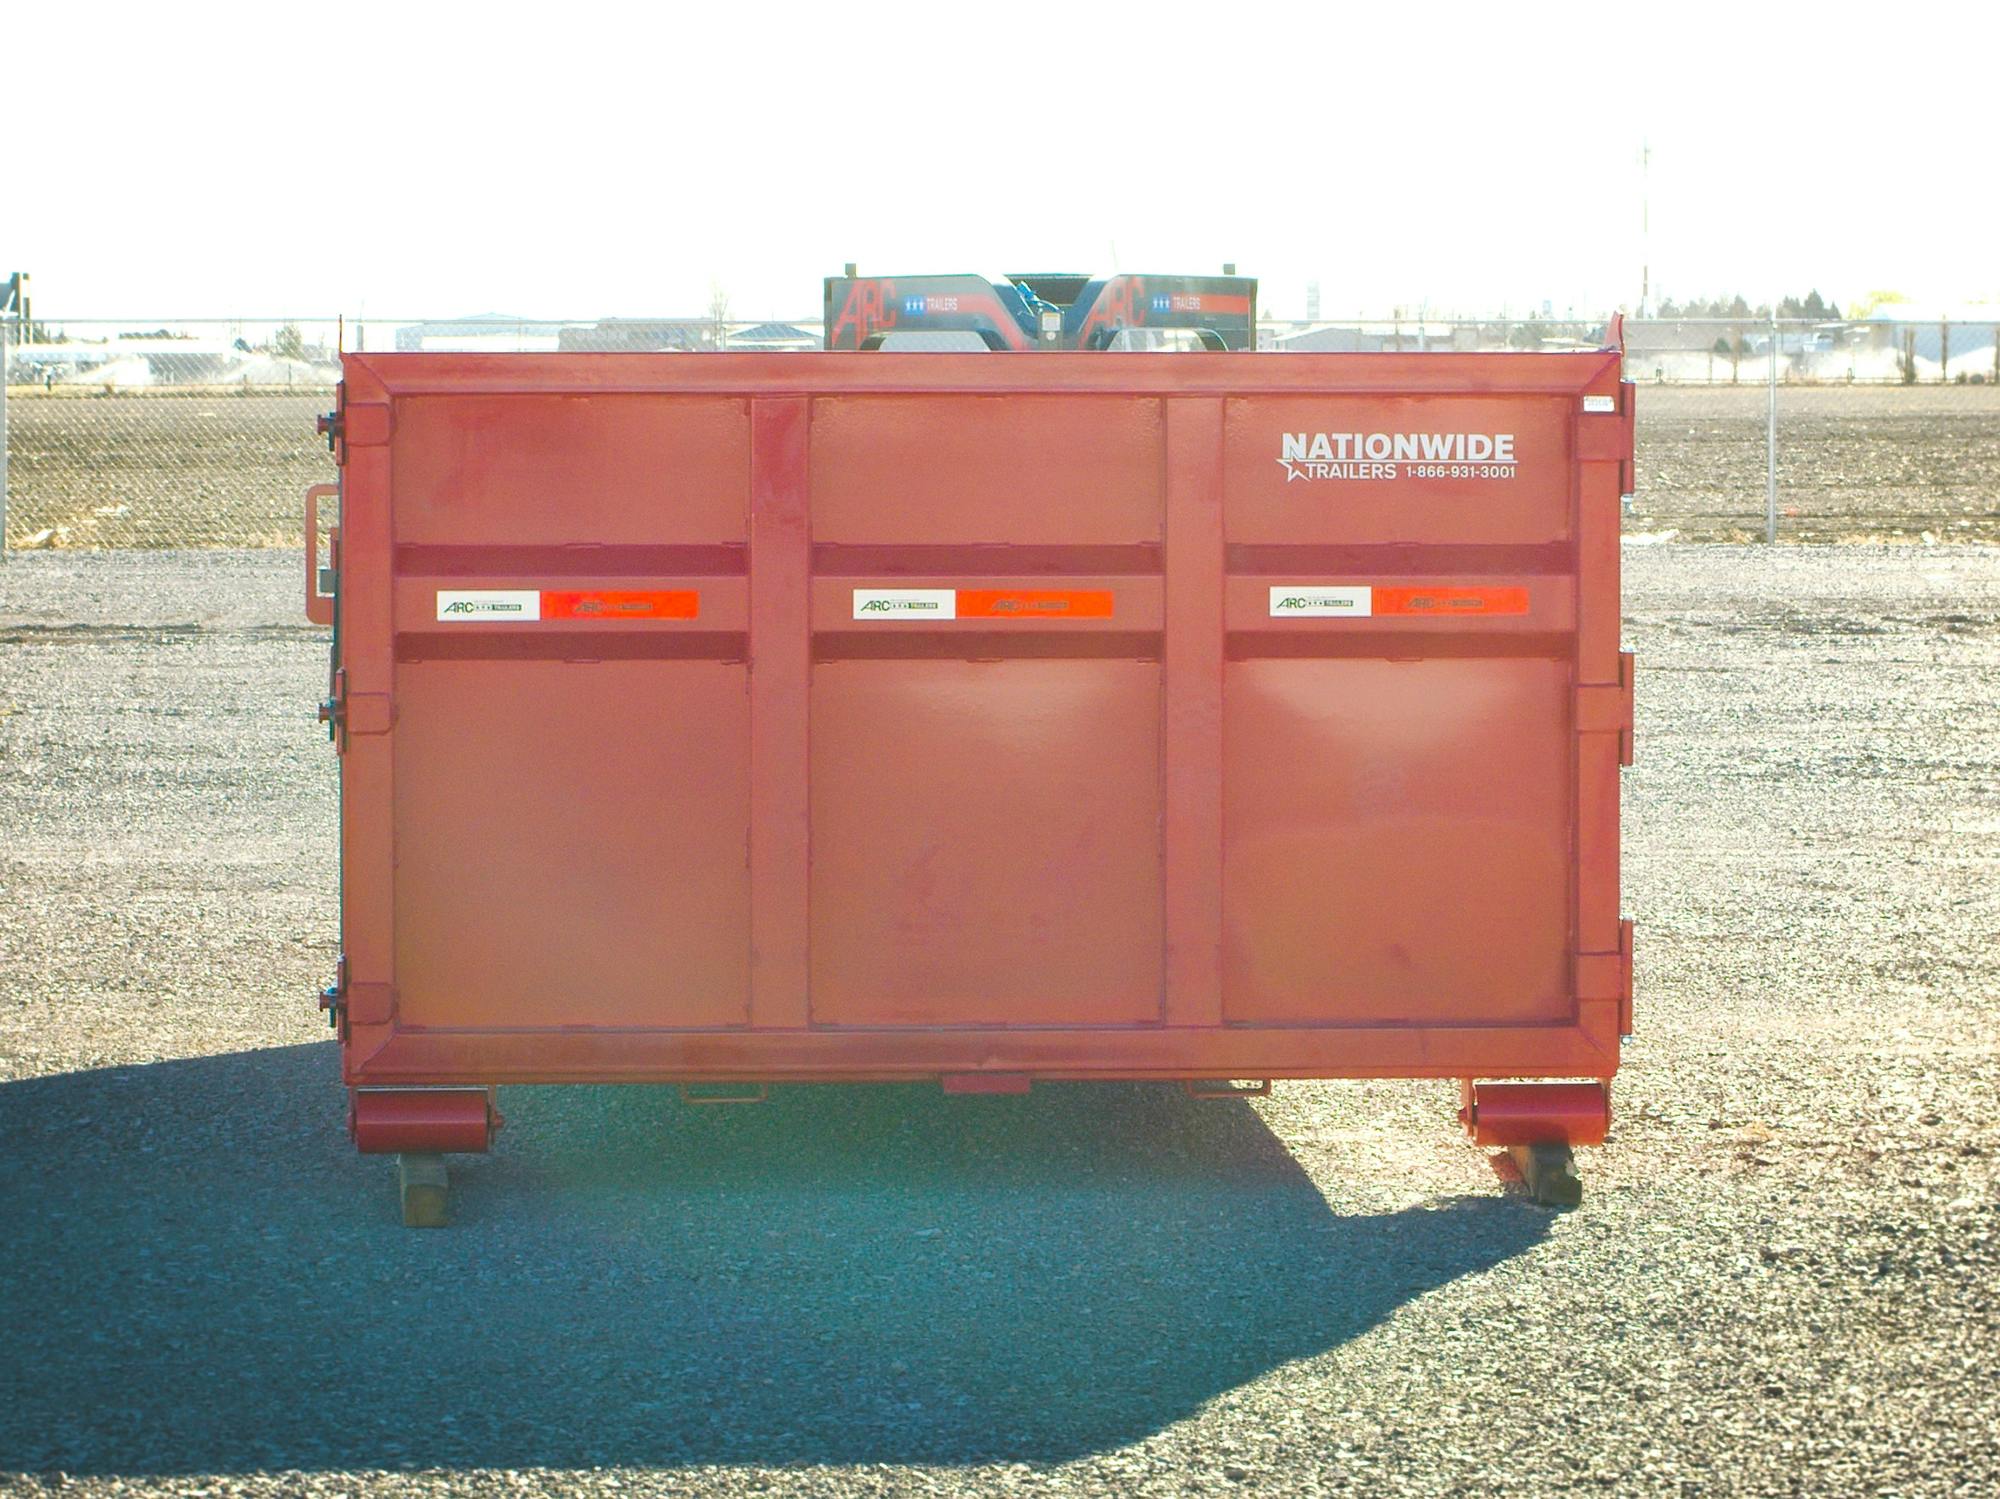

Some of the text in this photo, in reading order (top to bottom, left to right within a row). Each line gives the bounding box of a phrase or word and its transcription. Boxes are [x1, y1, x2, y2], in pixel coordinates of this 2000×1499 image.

[926, 297, 958, 311] TRAILERS
[1173, 296, 1201, 310] TRAILERS
[1282, 433, 1515, 460] NATIONWIDE
[1305, 463, 1515, 480] TRAILERS 1-866-931-3001
[444, 602, 474, 613] ARC
[861, 600, 890, 611] ARC
[1276, 597, 1306, 608] ARC
